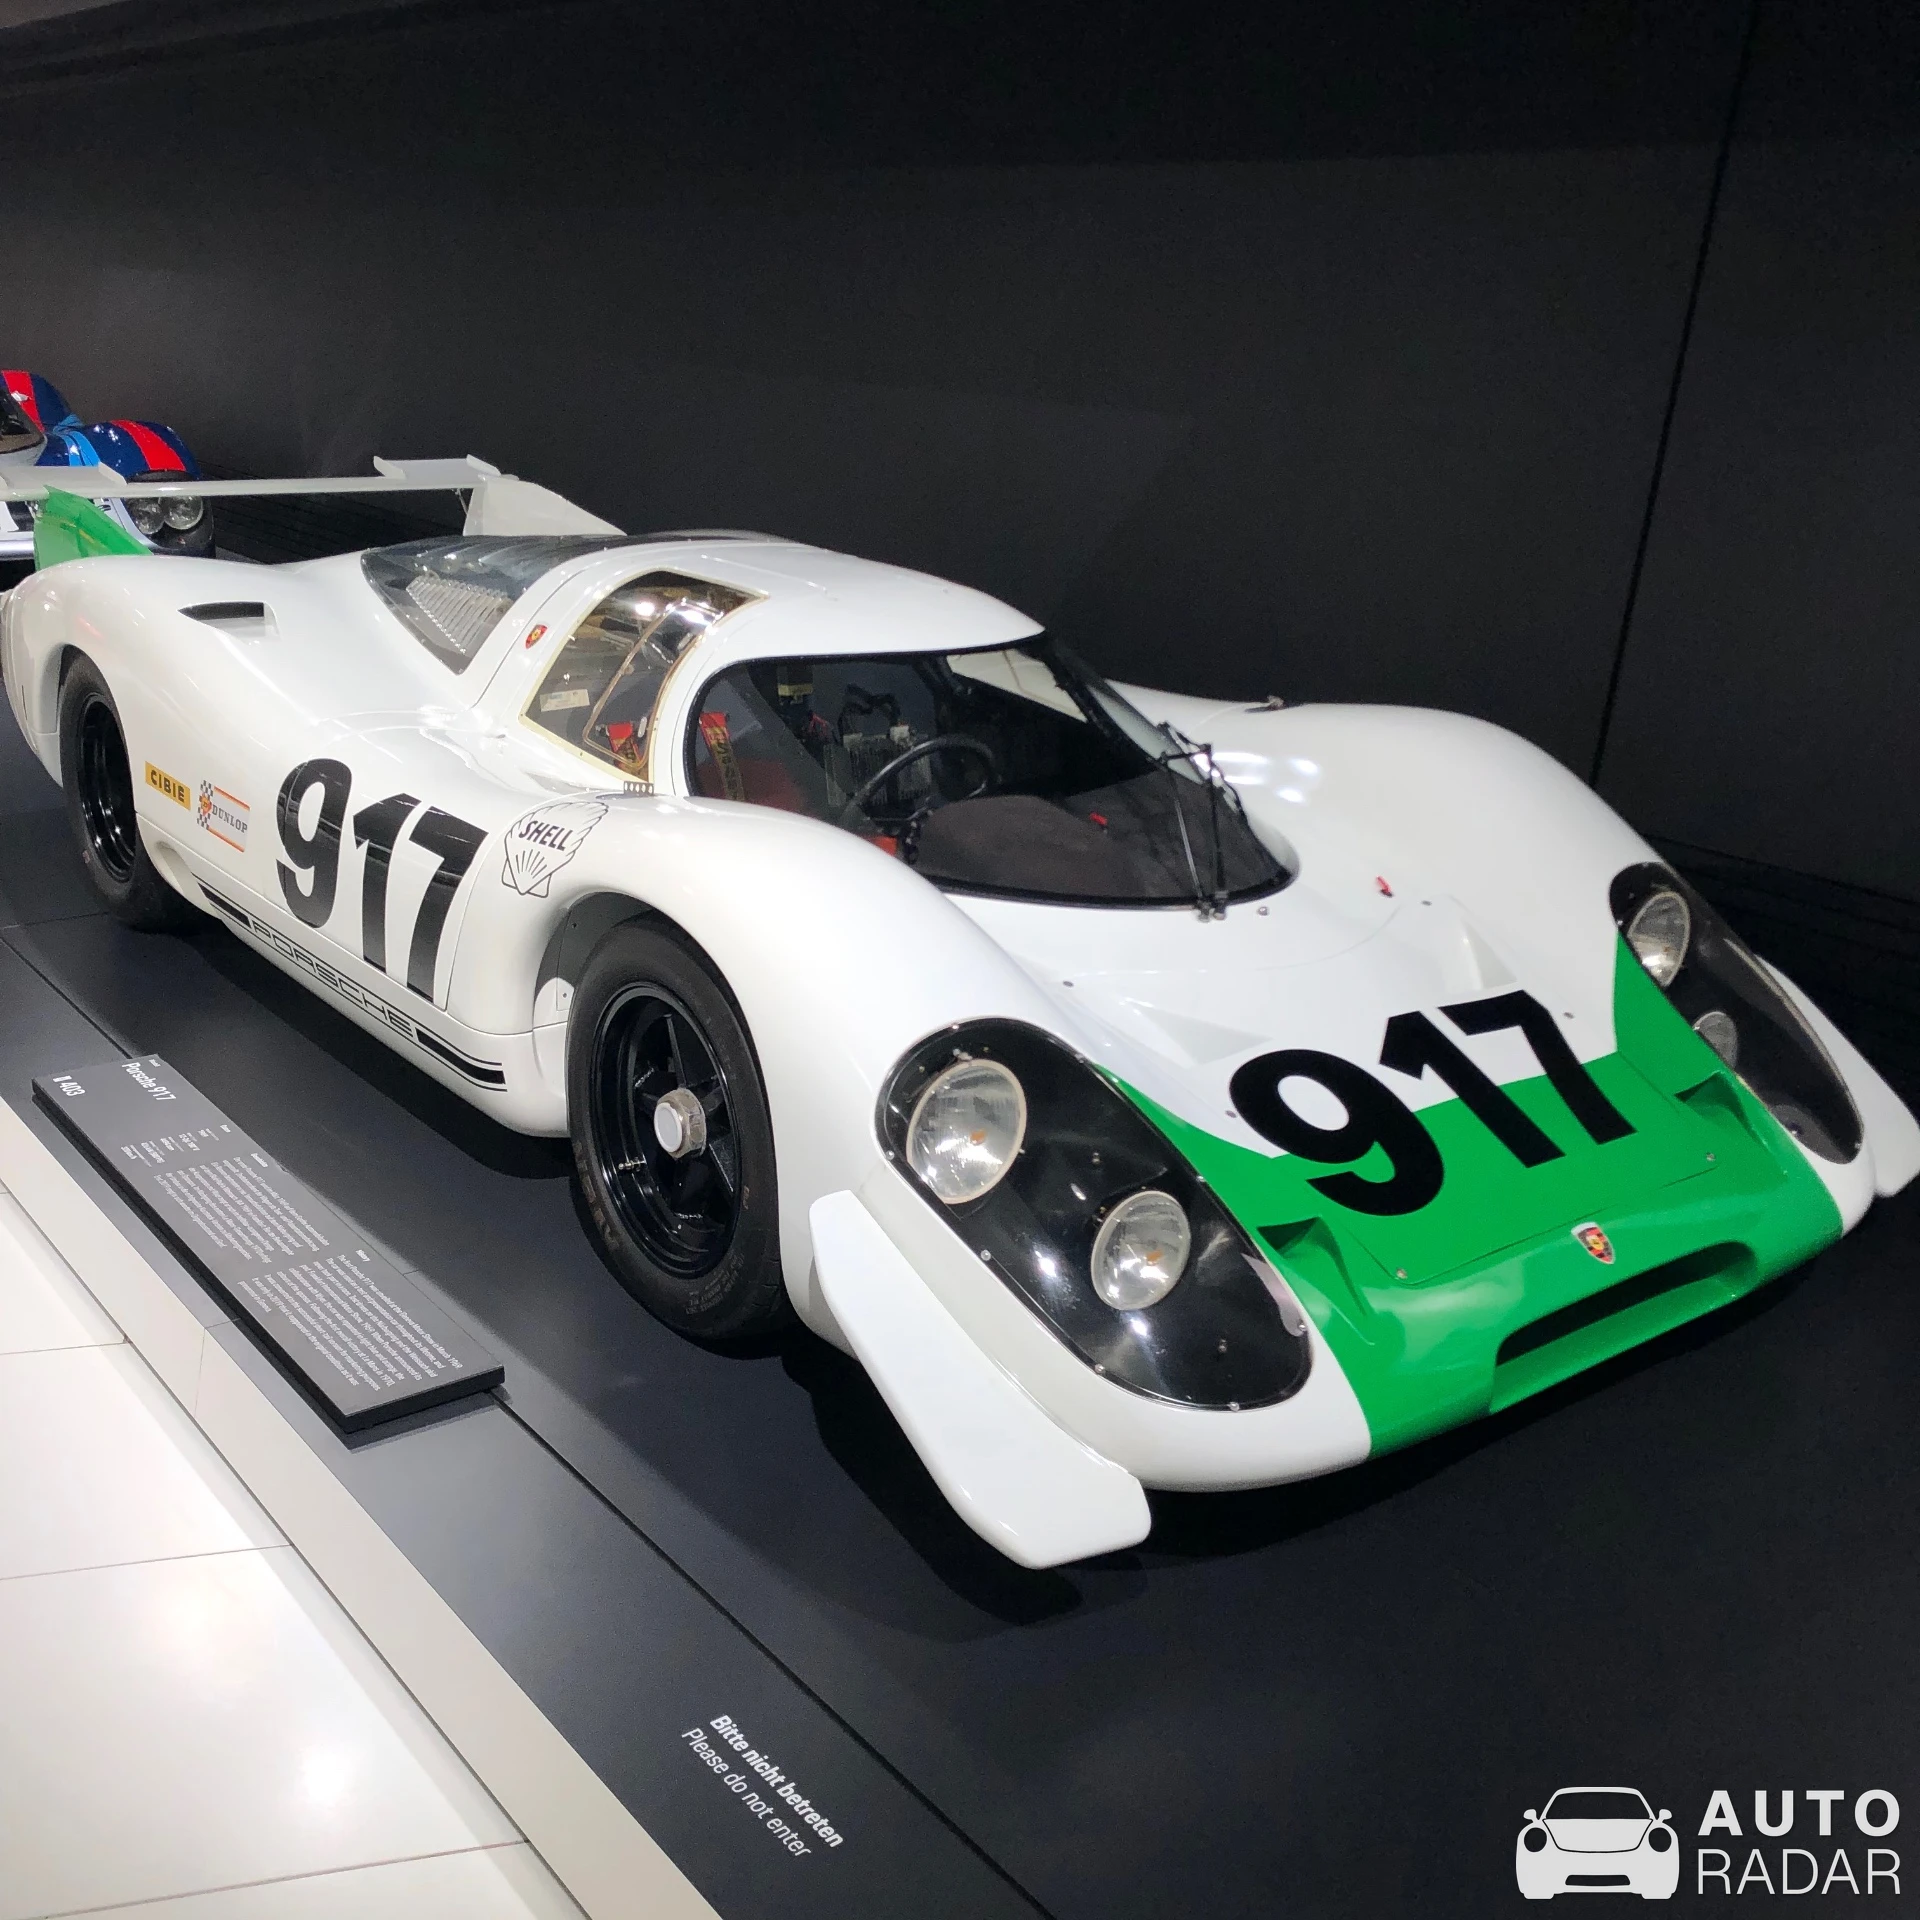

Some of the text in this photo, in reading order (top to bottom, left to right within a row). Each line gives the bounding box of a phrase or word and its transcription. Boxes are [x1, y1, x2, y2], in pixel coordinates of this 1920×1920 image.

[150, 769, 186, 804] CIBIE
[211, 804, 248, 833] DUNLOP
[517, 819, 573, 853] SHELL
[275, 757, 490, 1004] 917
[250, 919, 414, 1038] PORSCHE
[58, 1080, 86, 1097] 403
[121, 1062, 156, 1089] Porsche
[150, 1085, 177, 1101] 917
[1229, 988, 1638, 1217] 917
[681, 1727, 811, 1856] Please do not enter
[710, 1714, 844, 1848] Bitte nicht betreten
